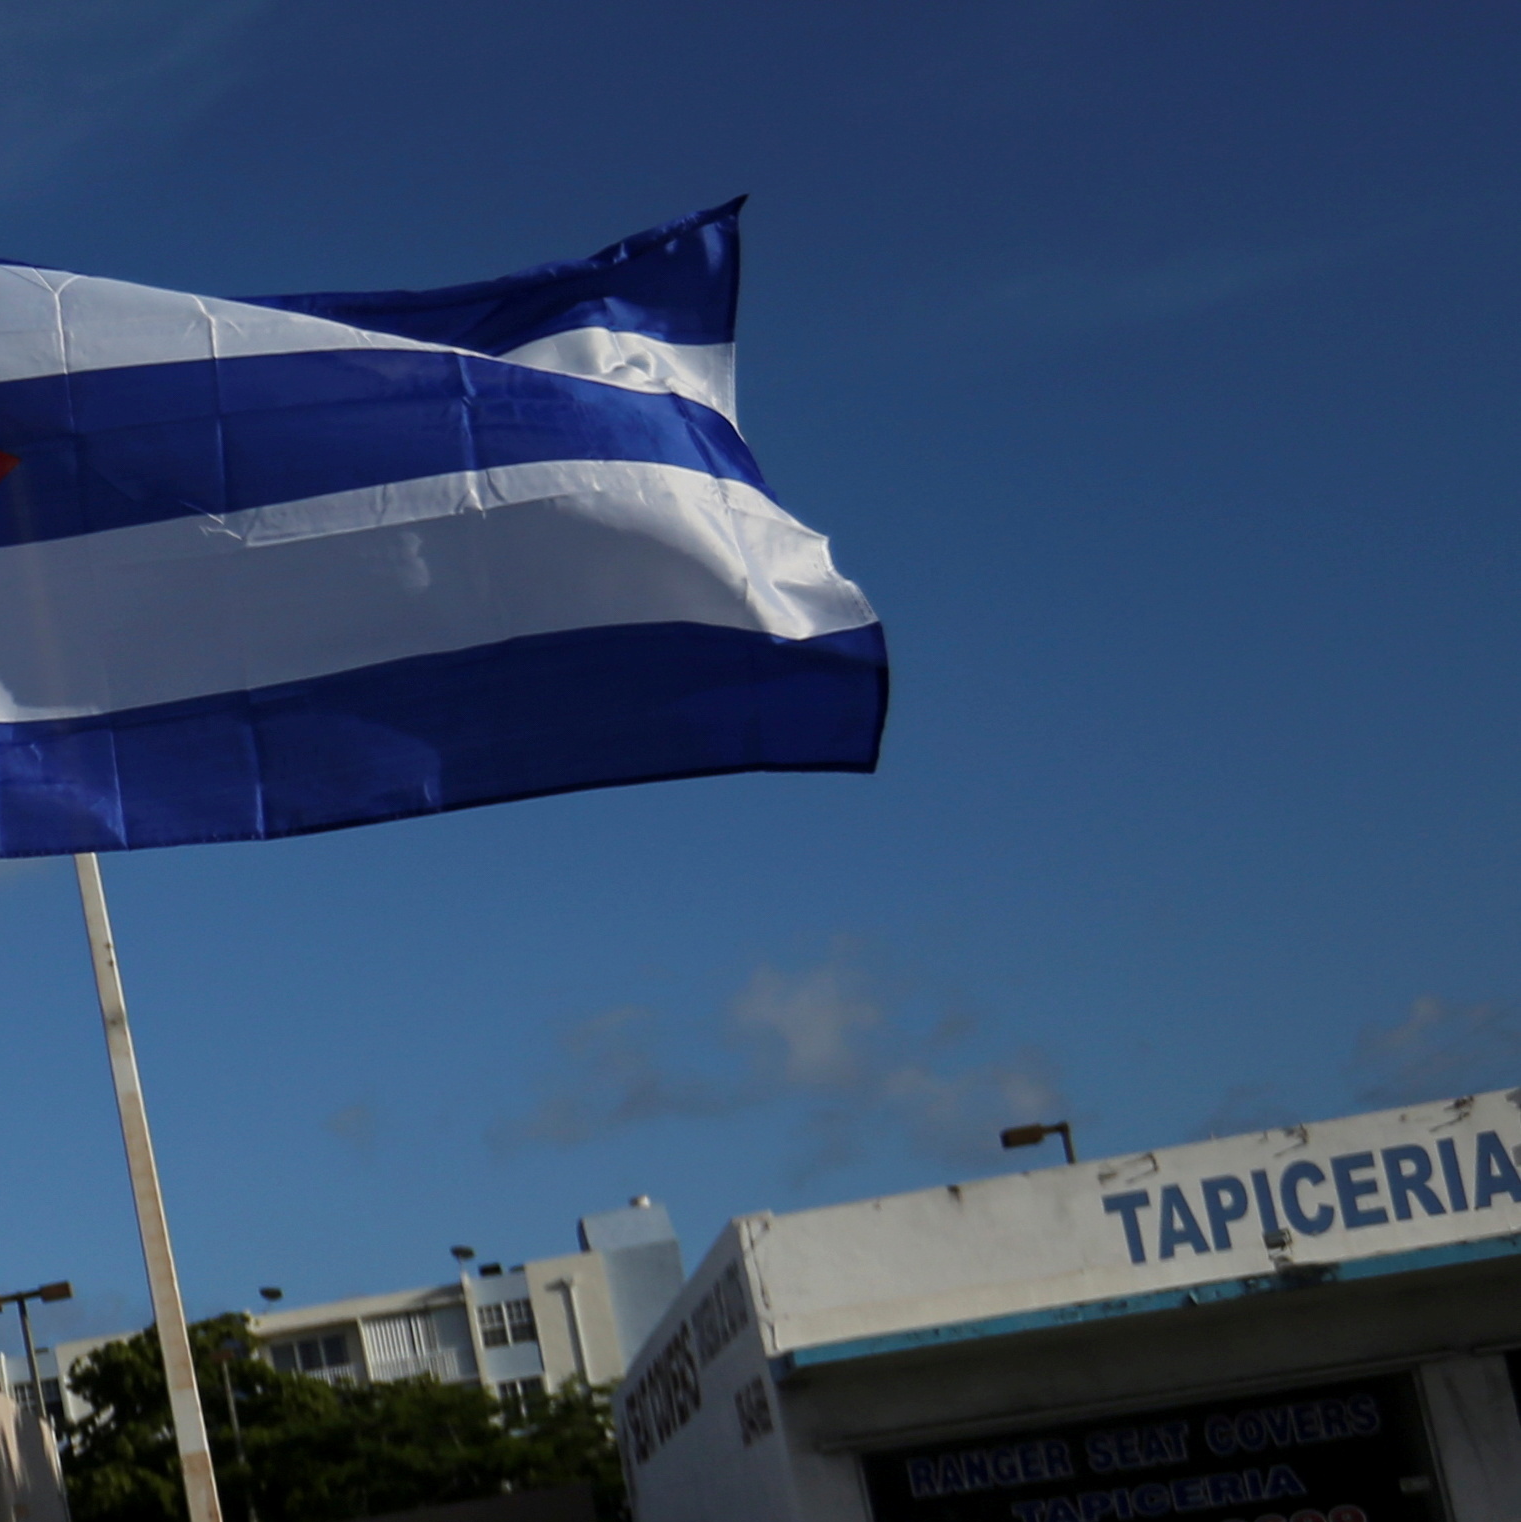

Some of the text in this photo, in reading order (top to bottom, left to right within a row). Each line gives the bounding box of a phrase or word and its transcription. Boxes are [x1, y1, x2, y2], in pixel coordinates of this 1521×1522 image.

[1101, 1130, 1521, 1265] TAPICERIA
[906, 1393, 1383, 1499] RANGER SEAT COVERS
